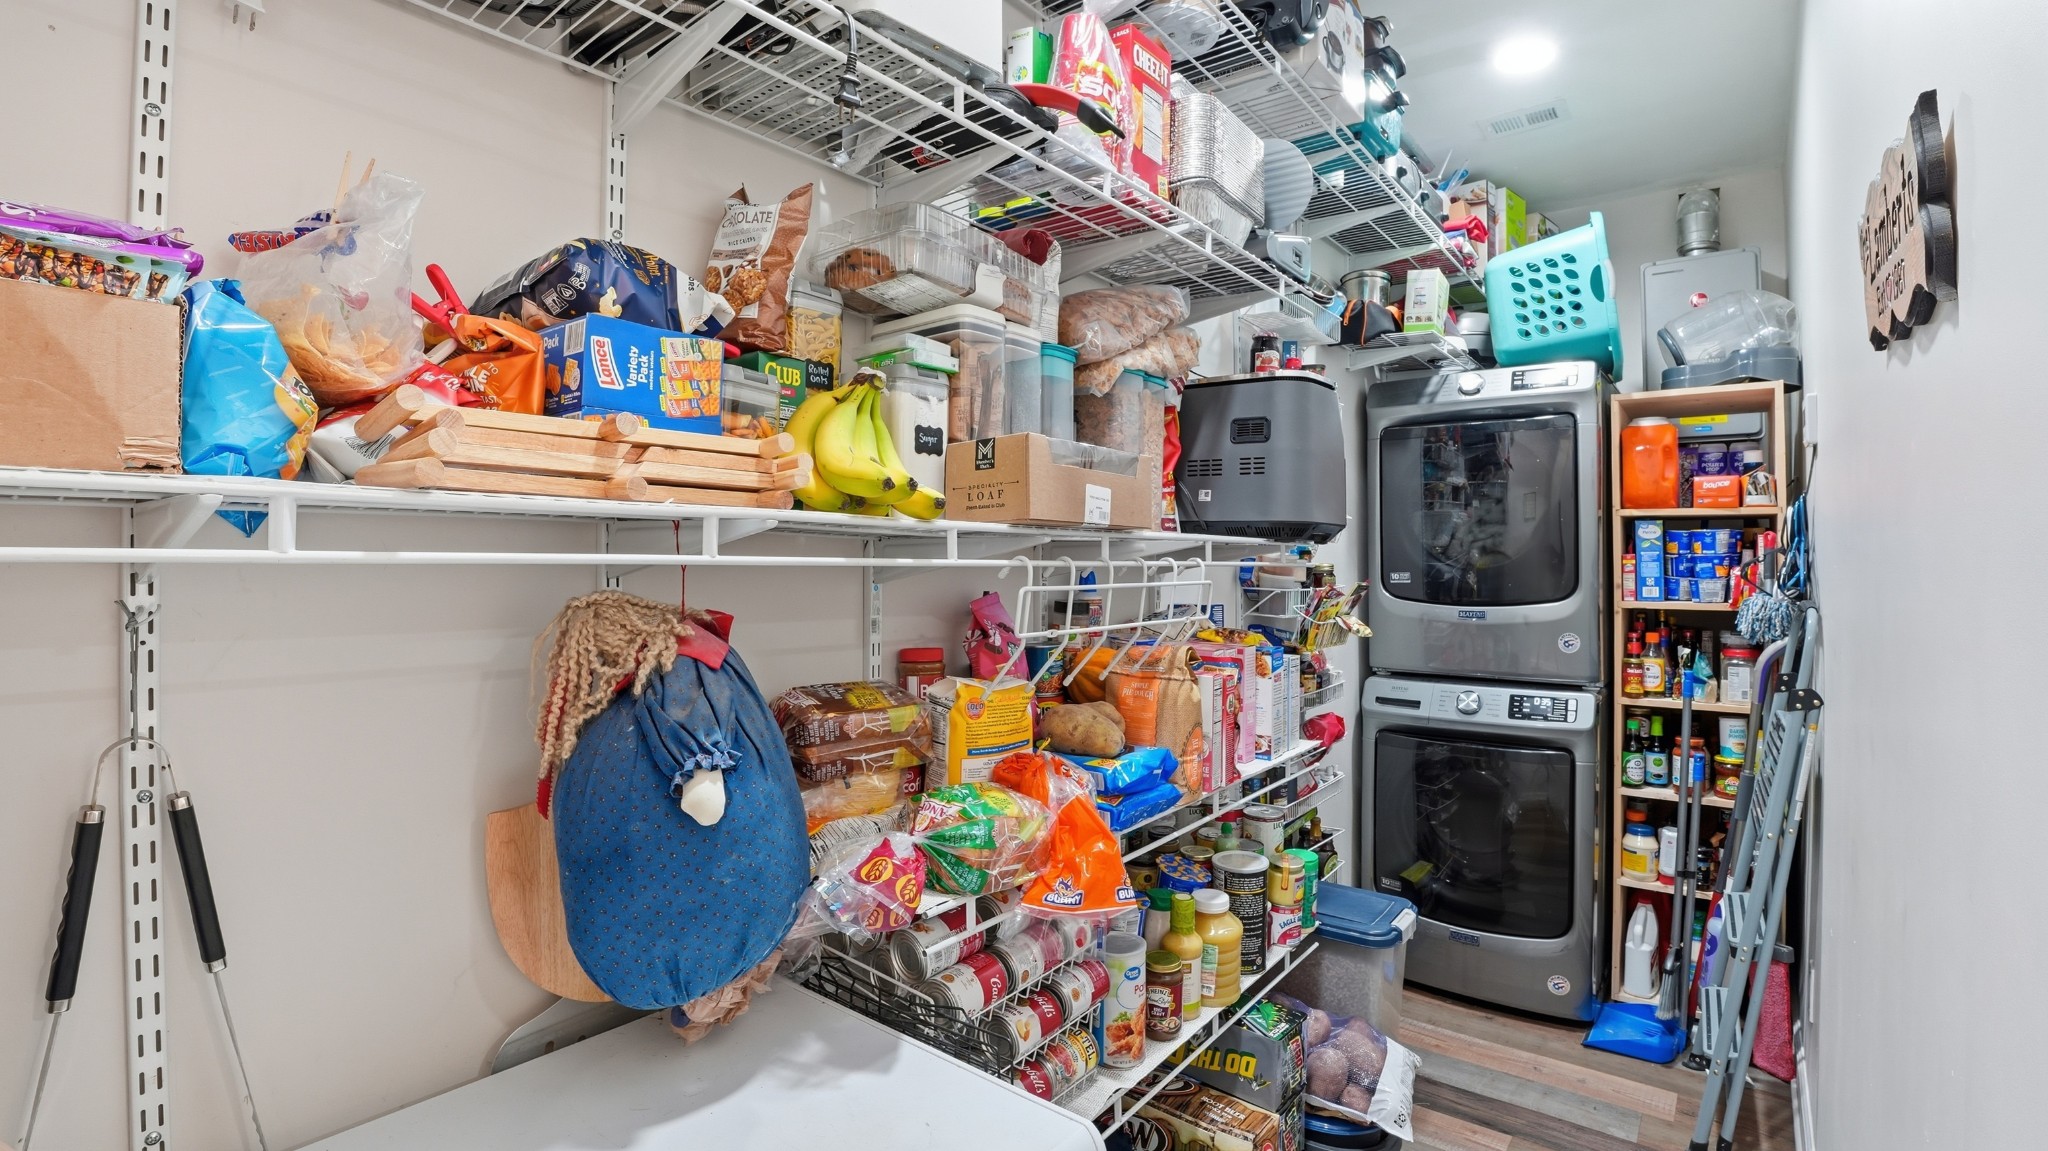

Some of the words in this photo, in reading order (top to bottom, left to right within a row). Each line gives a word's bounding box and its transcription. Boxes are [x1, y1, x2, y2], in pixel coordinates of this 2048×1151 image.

[1117, 28, 1130, 36] BAGS
[1133, 43, 1169, 88] CHEEZ-IT
[543, 333, 559, 350] Pack
[595, 339, 617, 387] Lance
[626, 345, 639, 388] Variety
[638, 354, 649, 384] Pack
[808, 363, 829, 376] Rolled
[764, 361, 801, 387] CLUB
[919, 432, 938, 447] Sugar
[968, 481, 1004, 490] SPECIALTY
[1703, 480, 1730, 489] bounce
[967, 489, 1005, 501] LOAF
[1122, 688, 1133, 697] PIE
[1046, 893, 1082, 905] BUNNY
[1279, 916, 1296, 930] EAGLE
[1149, 988, 1167, 996] HEINZ
[1225, 1048, 1257, 1080] DO
[1201, 1095, 1225, 1111] ROOT
[1225, 1106, 1247, 1121] BEER
